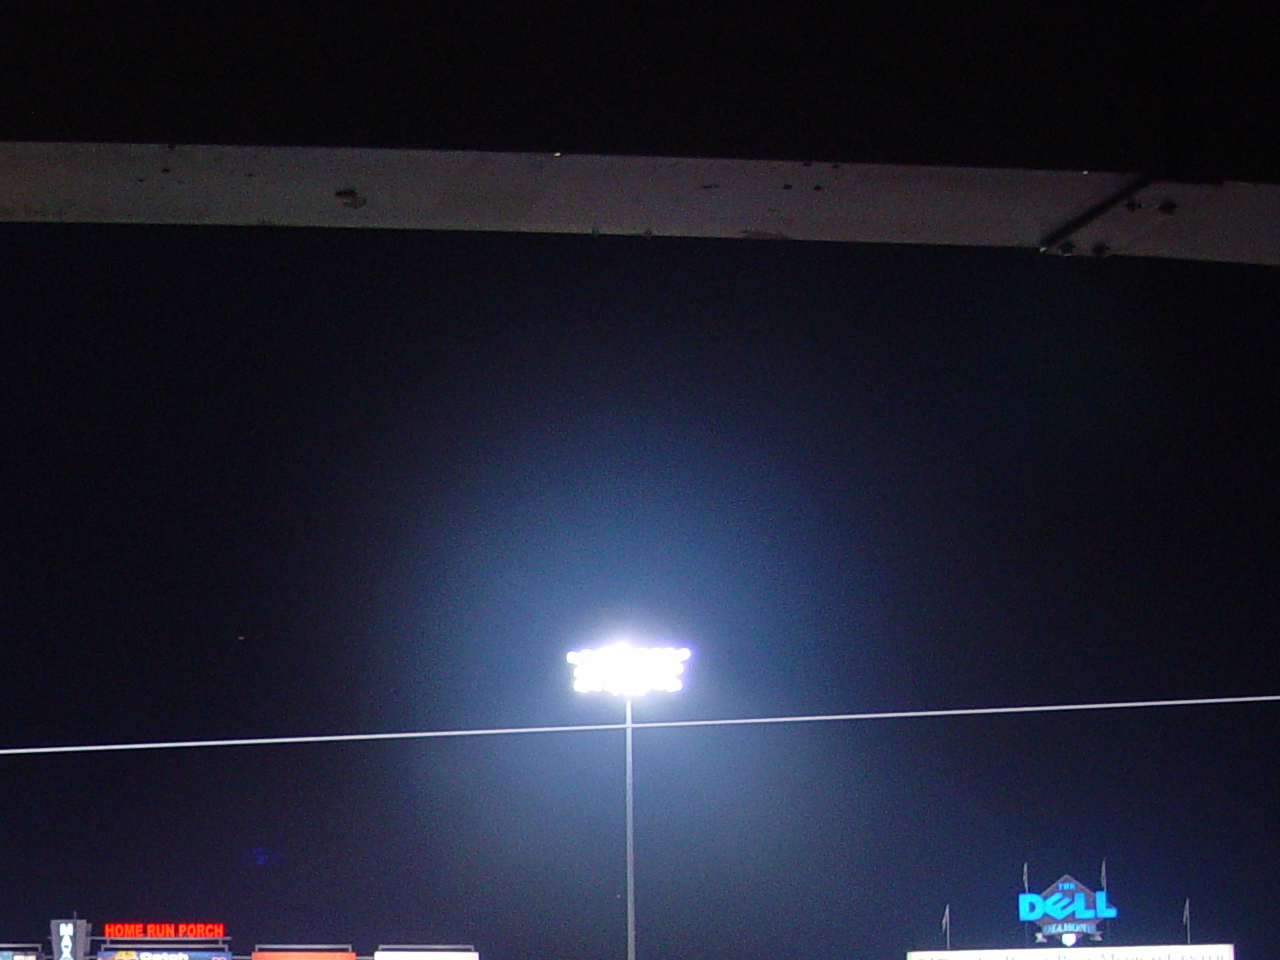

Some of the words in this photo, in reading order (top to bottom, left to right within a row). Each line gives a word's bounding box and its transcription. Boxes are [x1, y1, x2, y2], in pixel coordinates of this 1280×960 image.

[1018, 891, 1117, 921] DELL
[104, 923, 144, 937] HOME
[147, 923, 175, 937] RUN
[178, 923, 224, 937] PORCH
